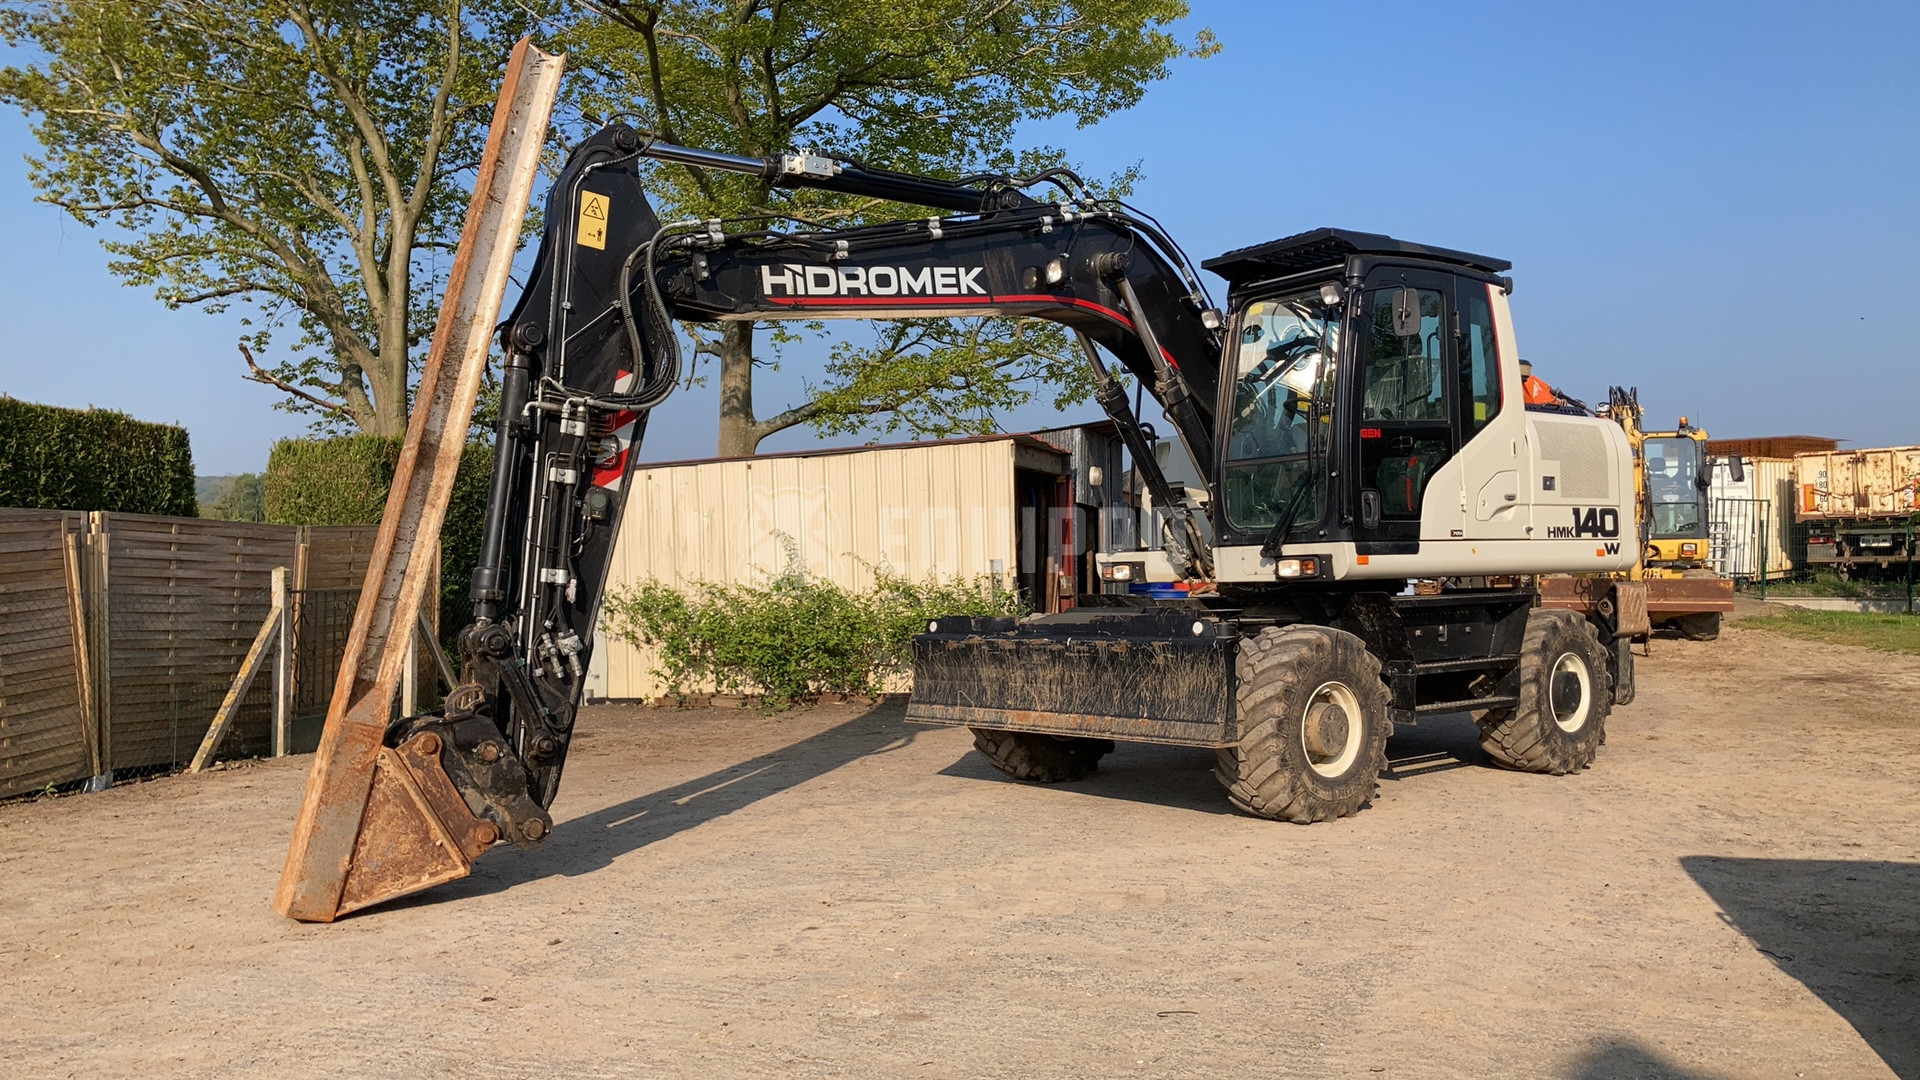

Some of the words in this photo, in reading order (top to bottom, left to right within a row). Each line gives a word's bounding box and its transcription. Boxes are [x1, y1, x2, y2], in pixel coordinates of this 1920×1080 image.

[1360, 428, 1382, 438] GEN
[1547, 526, 1575, 538] HMK
[1572, 507, 1619, 538] 140
[1604, 542, 1620, 555] W
